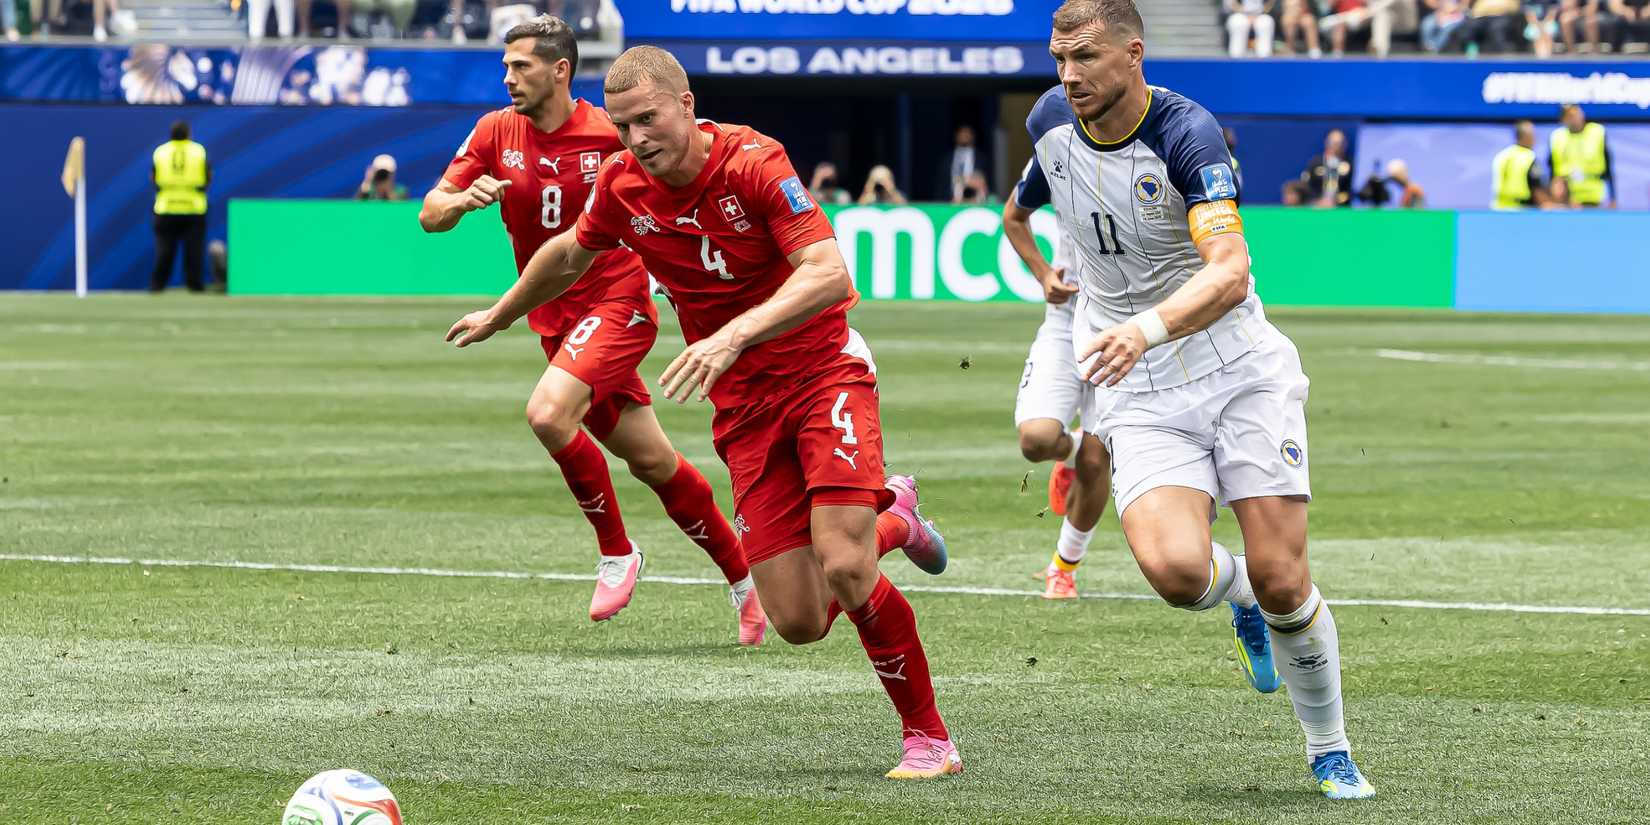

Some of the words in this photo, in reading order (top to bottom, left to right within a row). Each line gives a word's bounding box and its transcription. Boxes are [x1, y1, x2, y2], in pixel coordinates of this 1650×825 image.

[706, 47, 798, 74] LOS
[807, 47, 1024, 74] ANGELES
[541, 185, 562, 229] 8
[1091, 212, 1125, 254] 11
[700, 234, 734, 280] 4
[568, 316, 601, 345] 8
[831, 392, 857, 444] 4
